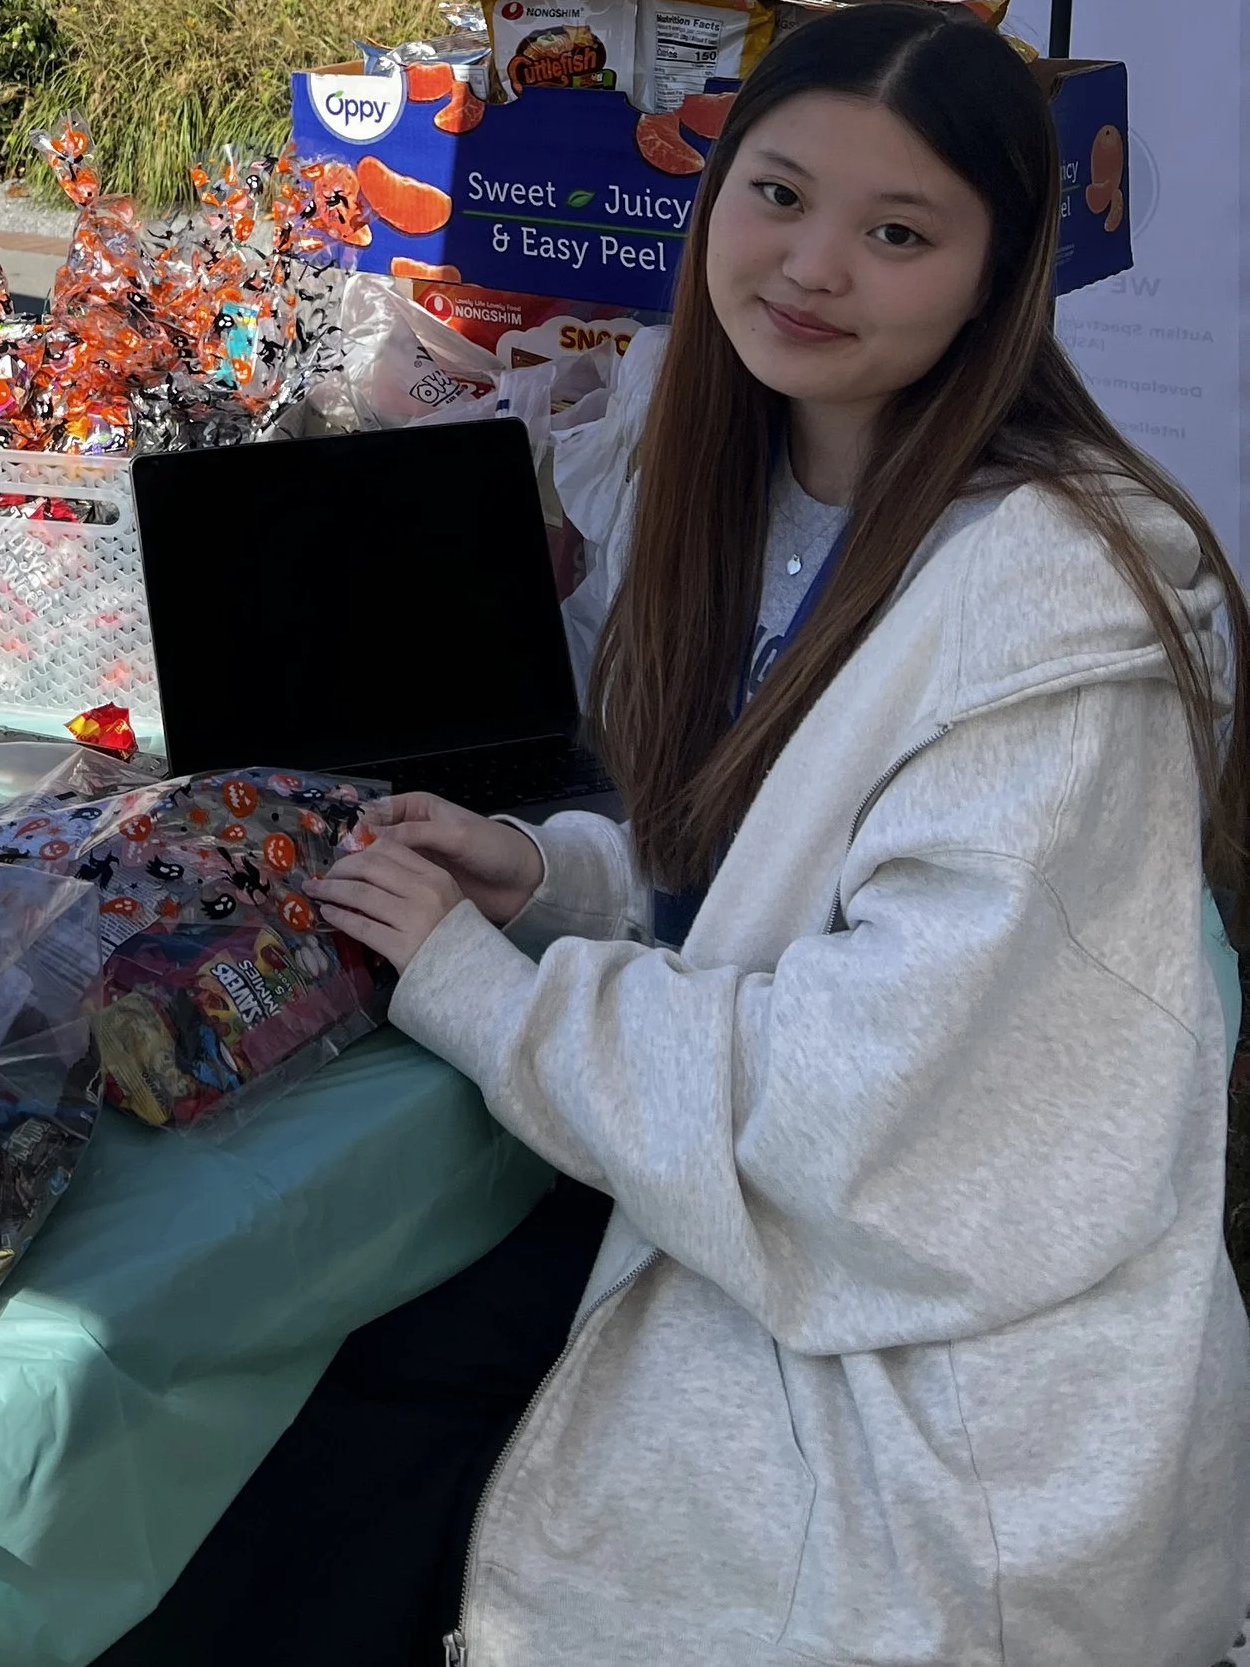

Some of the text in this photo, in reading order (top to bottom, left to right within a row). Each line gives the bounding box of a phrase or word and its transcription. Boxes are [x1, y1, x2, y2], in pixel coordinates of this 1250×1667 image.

[527, 7, 580, 18] NONGSHIM
[656, 15, 720, 31] Nutrition Facts
[695, 51, 717, 61] 150
[1061, 159, 1078, 183] icy
[468, 171, 692, 228] Sweet Juicy
[492, 223, 667, 271] & Easy Peel
[455, 305, 522, 325] NONGSHIM
[211, 962, 263, 1024] SAVERS
[238, 958, 283, 1017] MMIES
